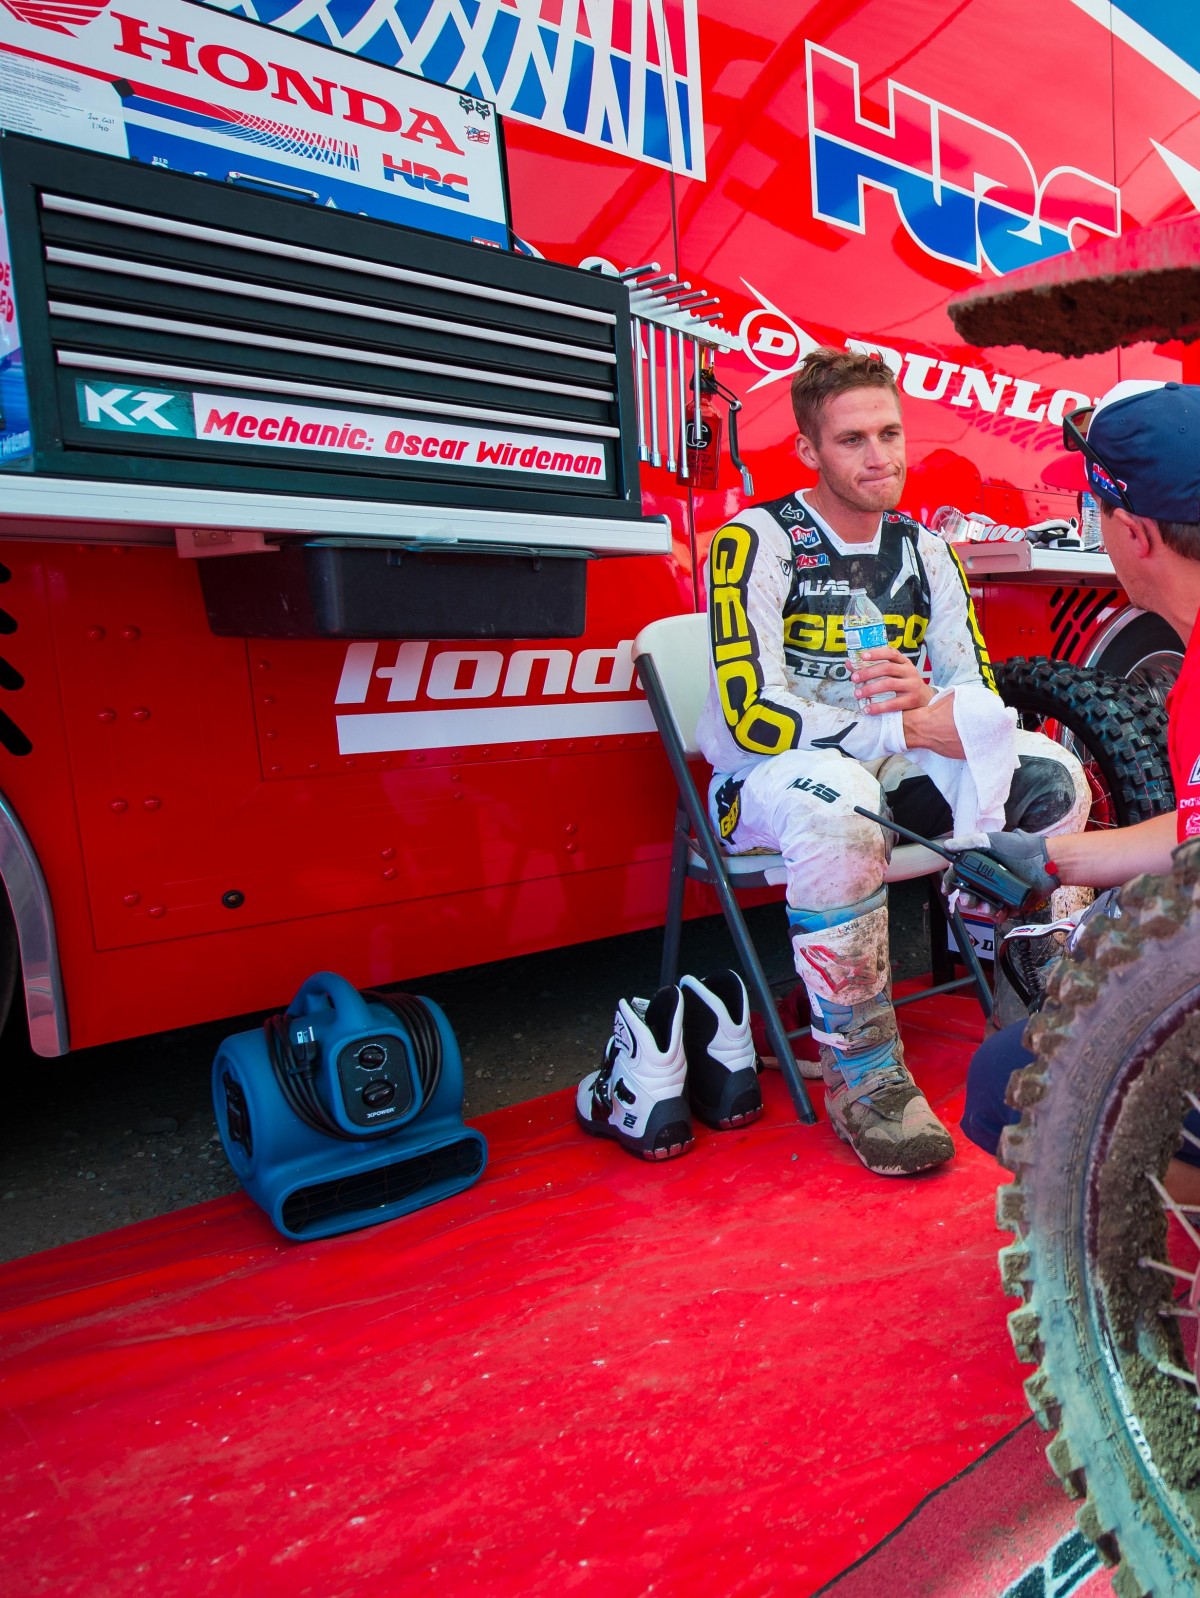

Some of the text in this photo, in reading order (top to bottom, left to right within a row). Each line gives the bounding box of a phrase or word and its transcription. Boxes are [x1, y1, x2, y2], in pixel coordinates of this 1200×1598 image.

[110, 11, 466, 156] HONDA
[382, 153, 470, 203] HRC
[805, 39, 1121, 276] HRC
[845, 337, 1102, 428] UNLO
[203, 408, 603, 476] Mechanic: Oscar Wirdeman
[711, 525, 798, 756] GEICO
[782, 613, 930, 653] GECO
[334, 640, 649, 705] Hond
[366, 1107, 396, 1119] XPOWER
